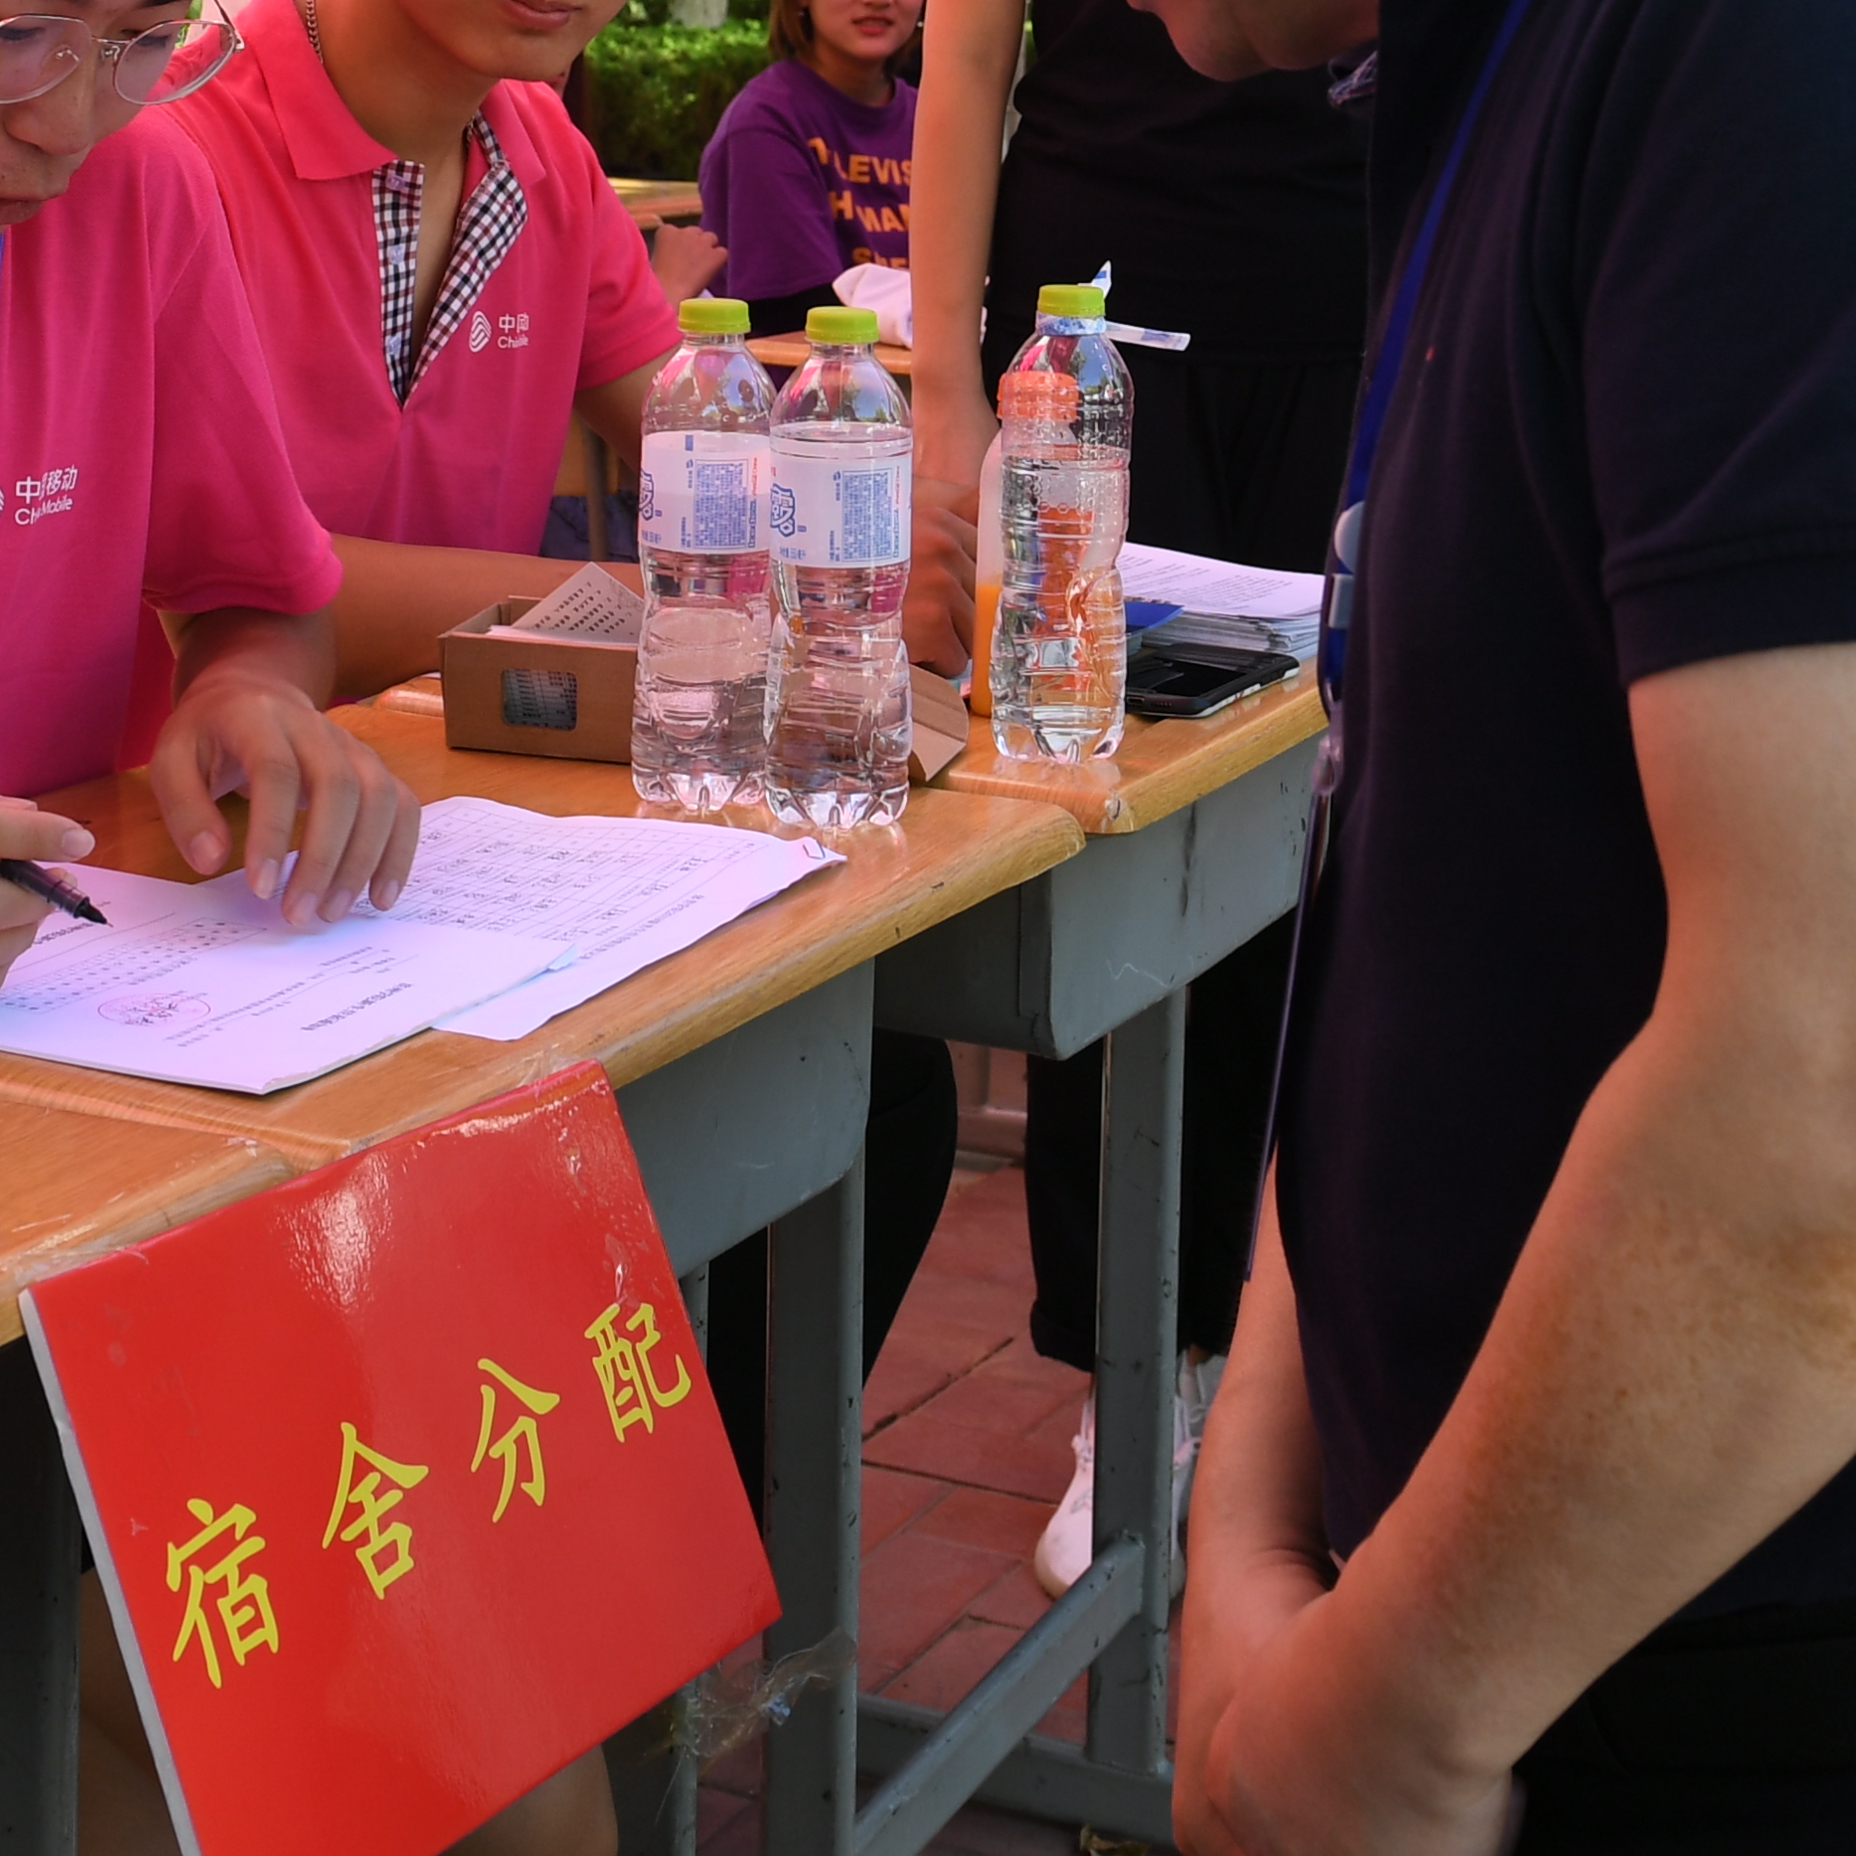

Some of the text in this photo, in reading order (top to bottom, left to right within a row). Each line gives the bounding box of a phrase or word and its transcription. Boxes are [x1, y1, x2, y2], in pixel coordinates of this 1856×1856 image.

[15, 465, 78, 505] 中移动
[165, 1301, 692, 1689] 宿舍分配
